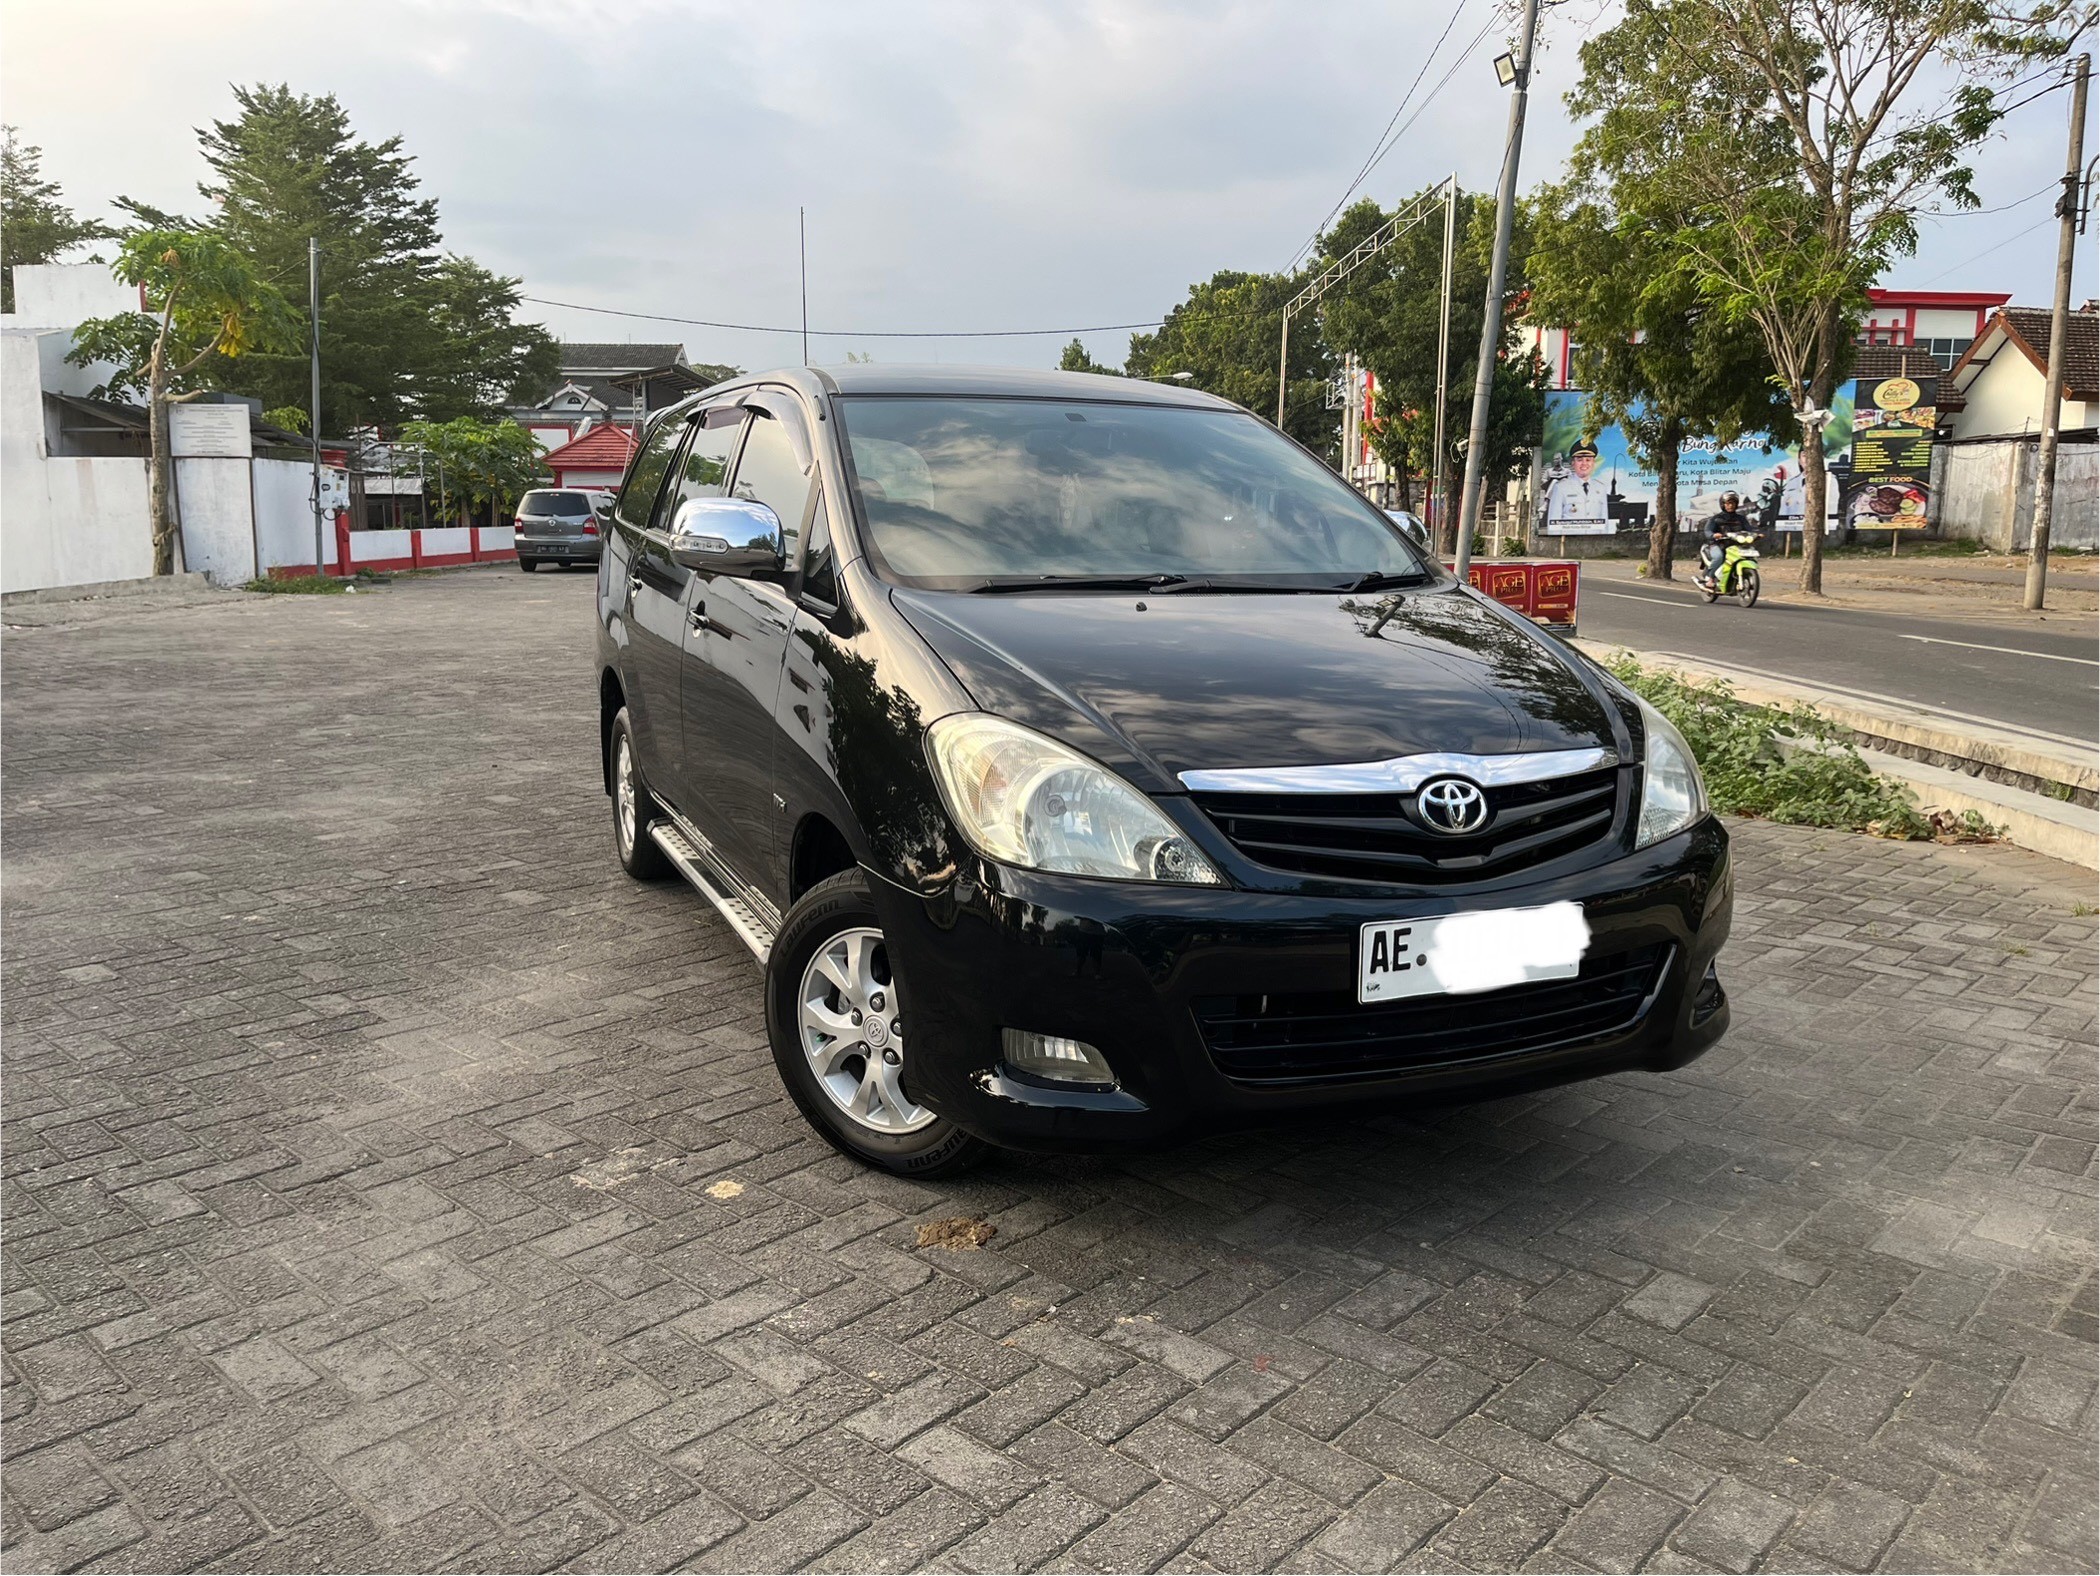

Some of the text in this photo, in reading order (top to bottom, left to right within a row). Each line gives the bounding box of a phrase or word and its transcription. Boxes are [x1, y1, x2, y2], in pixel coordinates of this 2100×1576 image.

[1682, 434, 1717, 454] Bung
[1699, 459, 1738, 467] Wujan
[1732, 468, 1751, 476] Maju
[1495, 576, 1524, 588] AGE
[1540, 575, 1569, 587] AGE
[1369, 927, 1412, 974] AE
